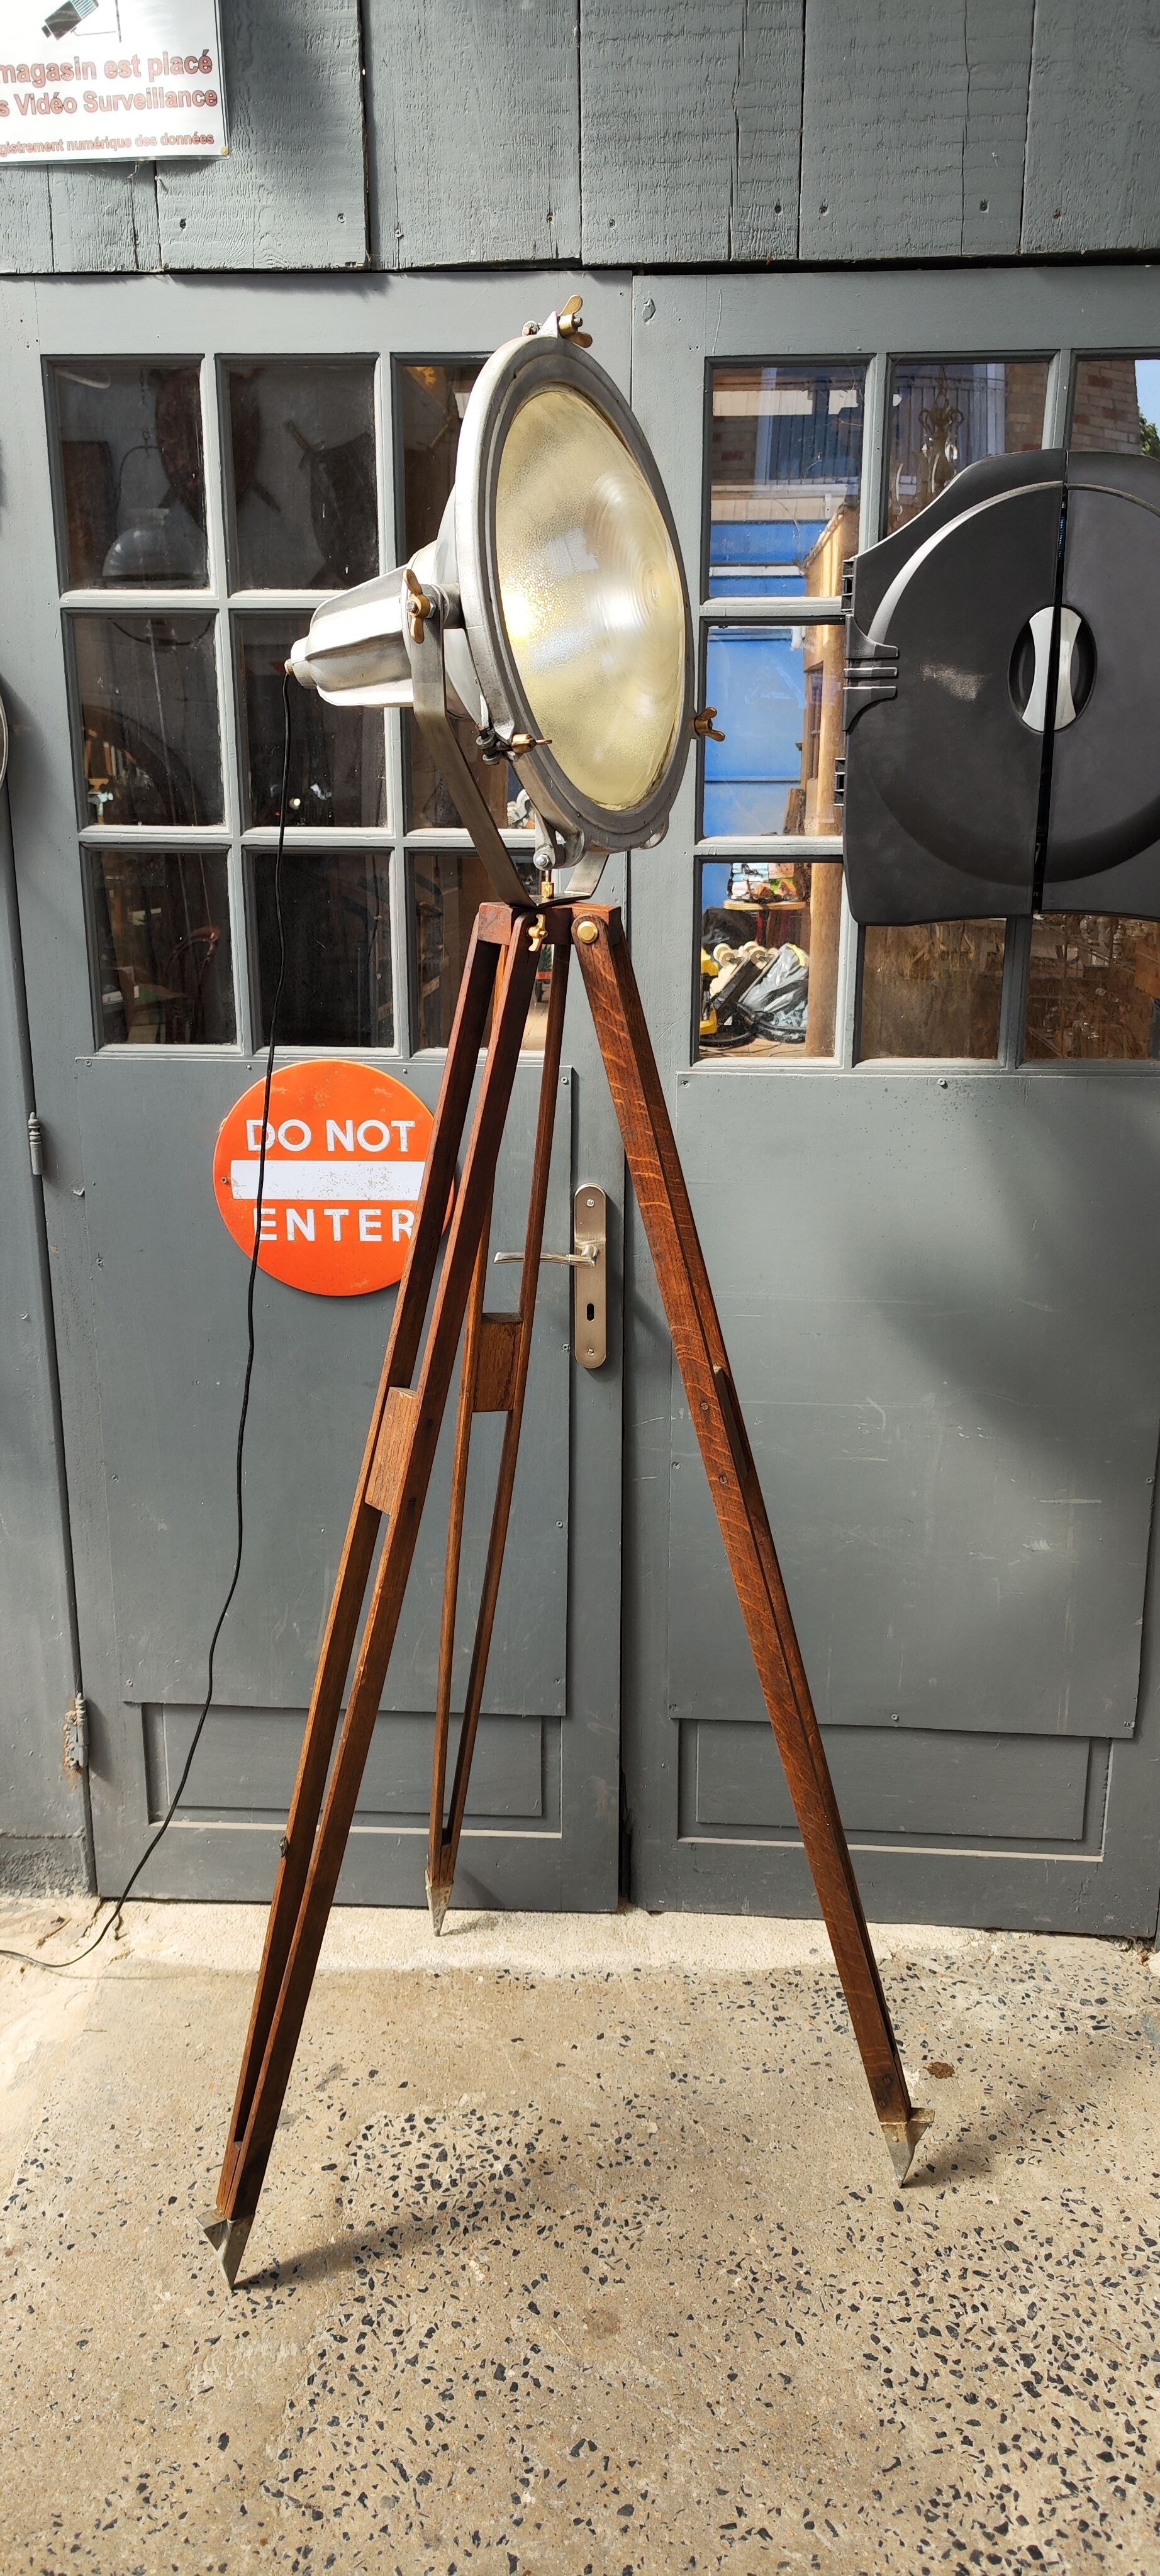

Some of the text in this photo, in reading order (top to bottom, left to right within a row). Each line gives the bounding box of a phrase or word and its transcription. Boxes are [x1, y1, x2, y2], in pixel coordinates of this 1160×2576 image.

[0, 49, 213, 88] magasin est placé
[13, 92, 77, 116] Vidéo
[83, 87, 218, 113] Surveillance
[67, 136, 132, 152] numérique
[135, 134, 157, 147] des
[160, 132, 215, 146] données
[246, 1119, 415, 1152] DO NOT
[253, 1208, 415, 1242] ENTER
